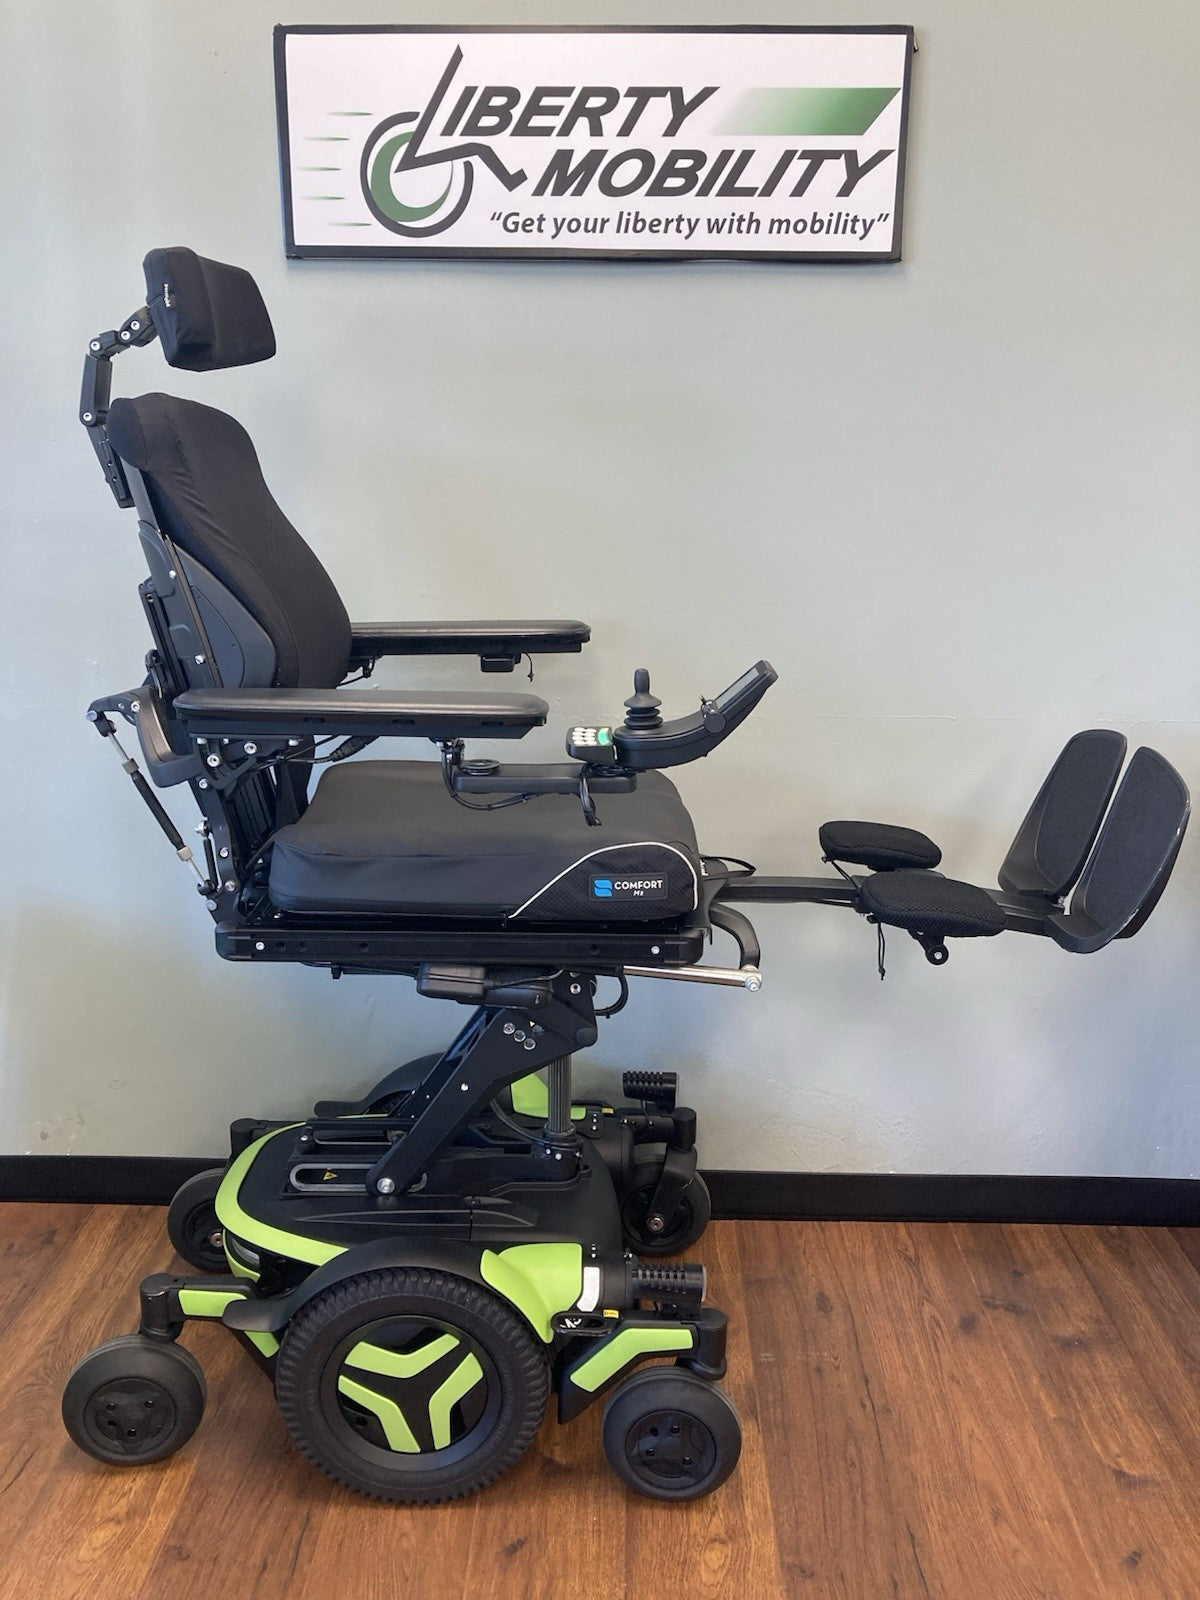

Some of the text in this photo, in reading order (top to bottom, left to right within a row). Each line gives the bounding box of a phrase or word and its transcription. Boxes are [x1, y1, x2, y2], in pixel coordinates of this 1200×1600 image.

[531, 148, 897, 198] MOBILITY
[551, 217, 610, 240] your
[615, 211, 701, 240] liberty
[706, 211, 761, 235] with
[614, 880, 663, 890] COMFORT
